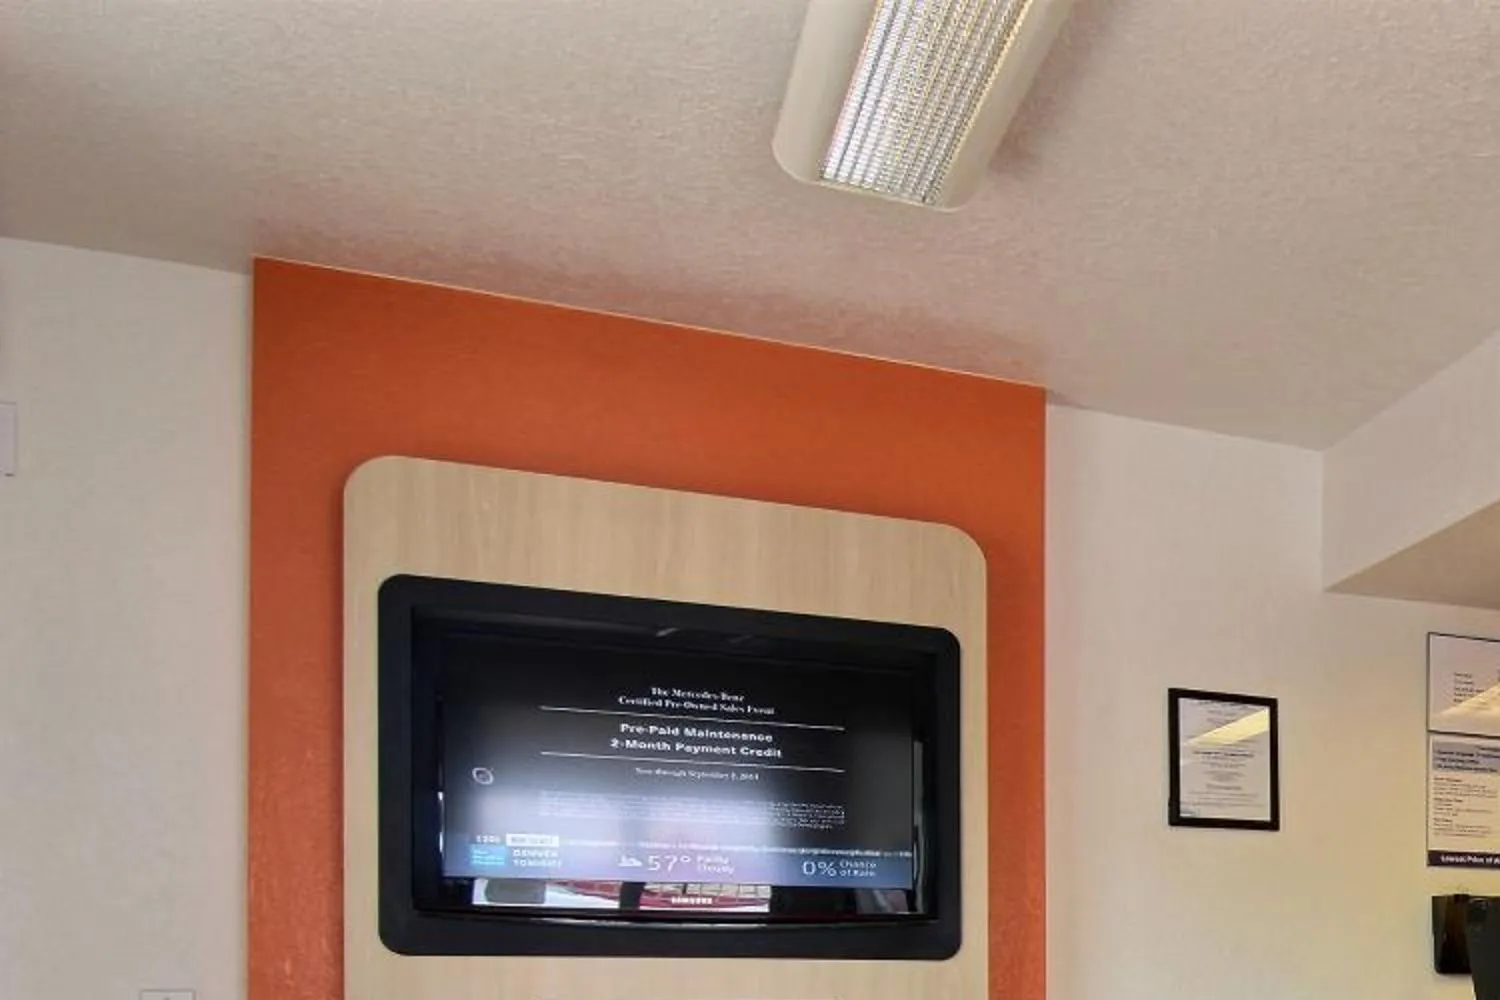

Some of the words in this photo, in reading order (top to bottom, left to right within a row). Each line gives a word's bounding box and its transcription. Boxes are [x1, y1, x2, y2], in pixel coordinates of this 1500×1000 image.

[620, 723, 680, 736] Pre-Paid
[684, 727, 773, 743] Maintenance
[610, 737, 671, 751] 2-Month
[675, 741, 736, 756] Payment
[740, 747, 783, 758] Credit
[802, 860, 837, 877] 0%
